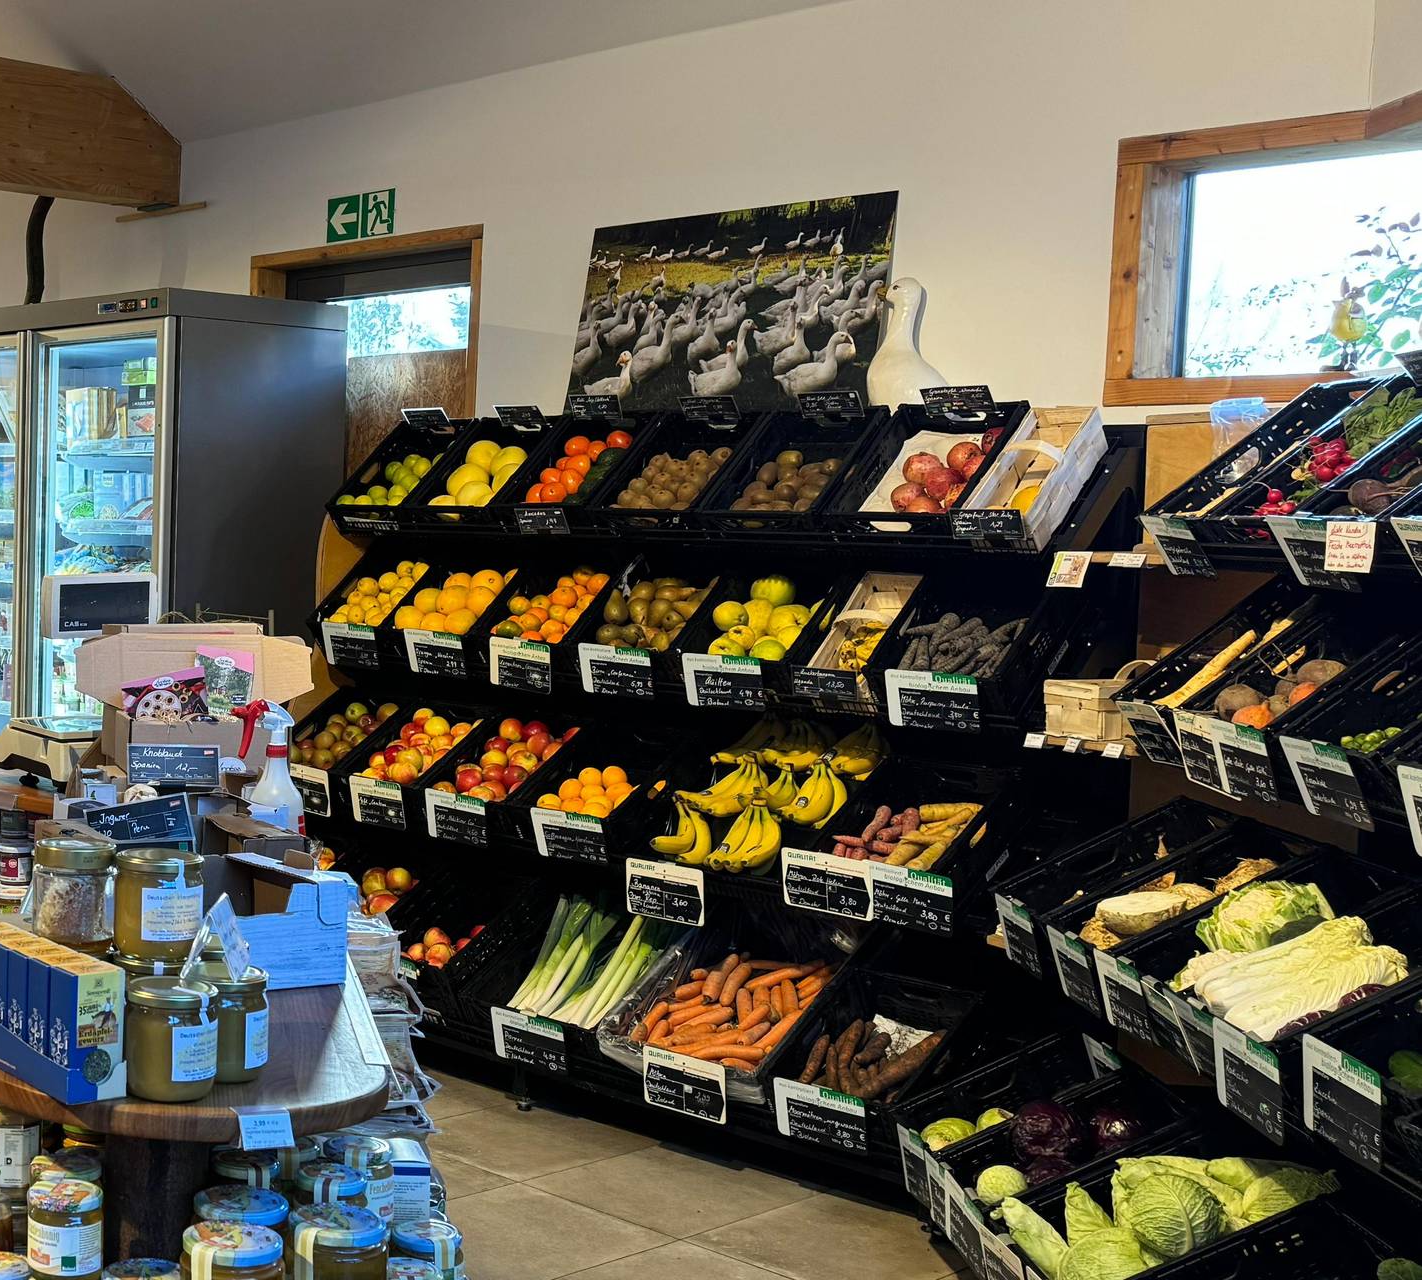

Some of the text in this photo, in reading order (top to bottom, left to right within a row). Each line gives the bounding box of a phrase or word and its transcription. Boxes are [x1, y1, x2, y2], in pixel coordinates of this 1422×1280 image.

[723, 657, 756, 666] Qualität
[934, 676, 971, 685] Qualität
[132, 822, 150, 834] Peru
[910, 872, 946, 886] Qualität
[924, 883, 945, 892] Anbau
[944, 914, 950, 922] €
[1342, 1058, 1375, 1084] Qualität
[822, 1092, 858, 1106] Qualität
[860, 1134, 866, 1142] €
[1374, 1134, 1380, 1146] €
